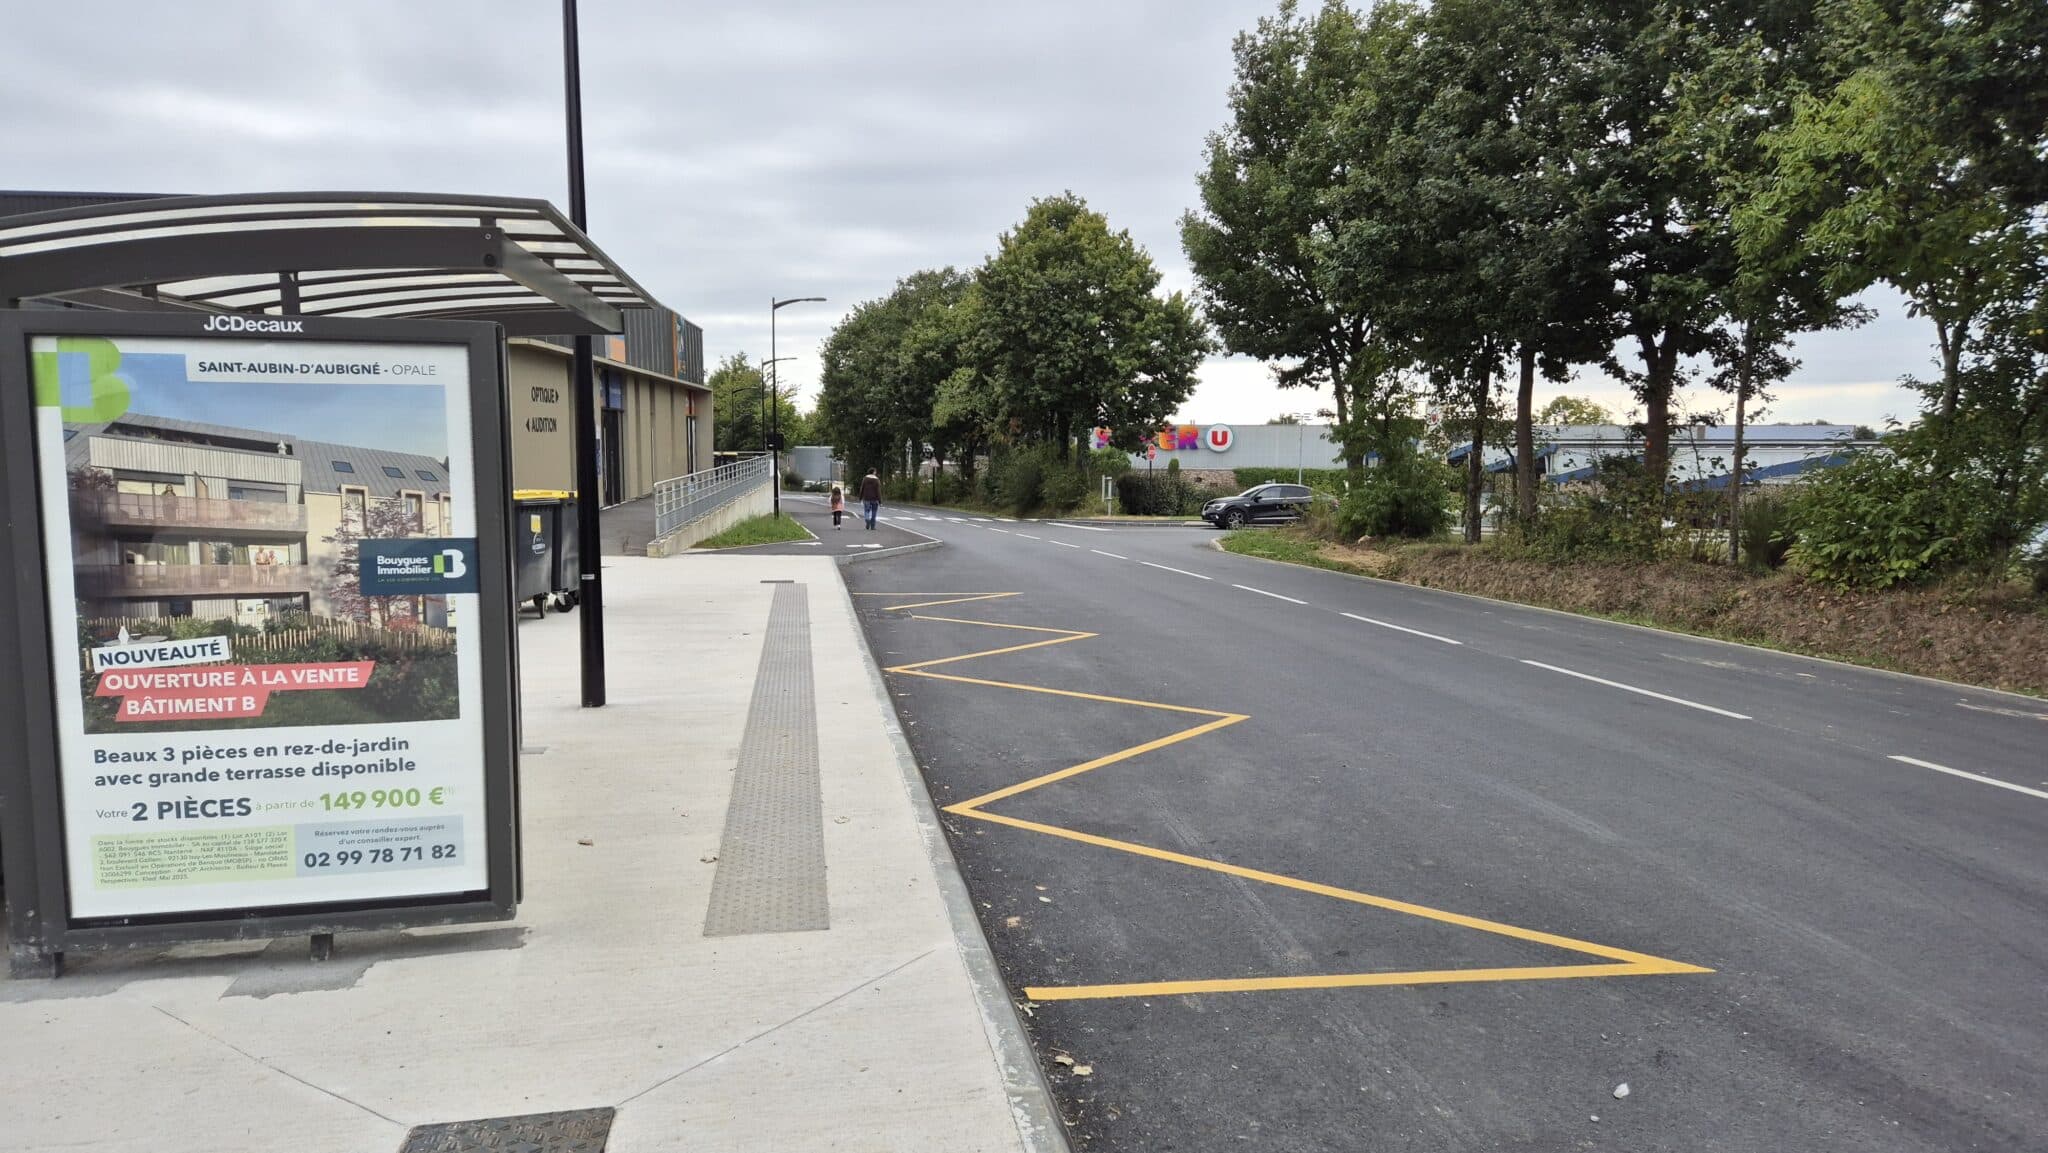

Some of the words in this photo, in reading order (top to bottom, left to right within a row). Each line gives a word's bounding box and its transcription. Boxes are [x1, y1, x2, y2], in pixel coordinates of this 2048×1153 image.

[203, 315, 303, 333] JCDecaux
[198, 361, 380, 375] SAINT-AUBIN-D'AUBIGNÉ
[391, 364, 437, 376] OPALE
[531, 386, 555, 404] OPTIQUE
[531, 417, 557, 432] AUDITION
[1211, 430, 1229, 447] U
[376, 555, 429, 567] Bouygues
[377, 565, 433, 575] Immobilier
[98, 640, 221, 666] NOUVEAUTÉ
[105, 671, 236, 690] OUVERTURE
[240, 667, 257, 687] À
[261, 669, 288, 685] LA
[290, 667, 359, 684] VENTE
[126, 696, 237, 715] BÂTIMENT
[242, 696, 256, 711] B
[94, 748, 157, 764] Beaux
[163, 747, 176, 762] 3
[181, 745, 248, 765] pièces
[253, 745, 278, 758] en
[284, 736, 410, 757] rez-de-jardin
[94, 773, 143, 787] avec
[148, 767, 220, 788] grande
[225, 766, 306, 782] terrasse
[311, 757, 417, 780] disponible
[95, 808, 128, 819] Votre
[131, 802, 149, 822] 2
[157, 795, 252, 820] PIÈCES
[255, 800, 262, 811] à
[265, 799, 296, 812] partir
[299, 798, 314, 809] de
[319, 790, 366, 812] 149
[371, 787, 421, 808] 900
[314, 828, 349, 837] Réservez
[350, 827, 370, 835] votre
[371, 825, 418, 834] rendez-vous
[419, 823, 445, 833] auprès
[338, 837, 355, 846] d'un
[357, 836, 393, 844] conseiller
[304, 852, 331, 868] 02
[336, 849, 363, 866] 99
[368, 848, 394, 864] 78
[400, 846, 423, 862] 71
[431, 844, 457, 860] 82
